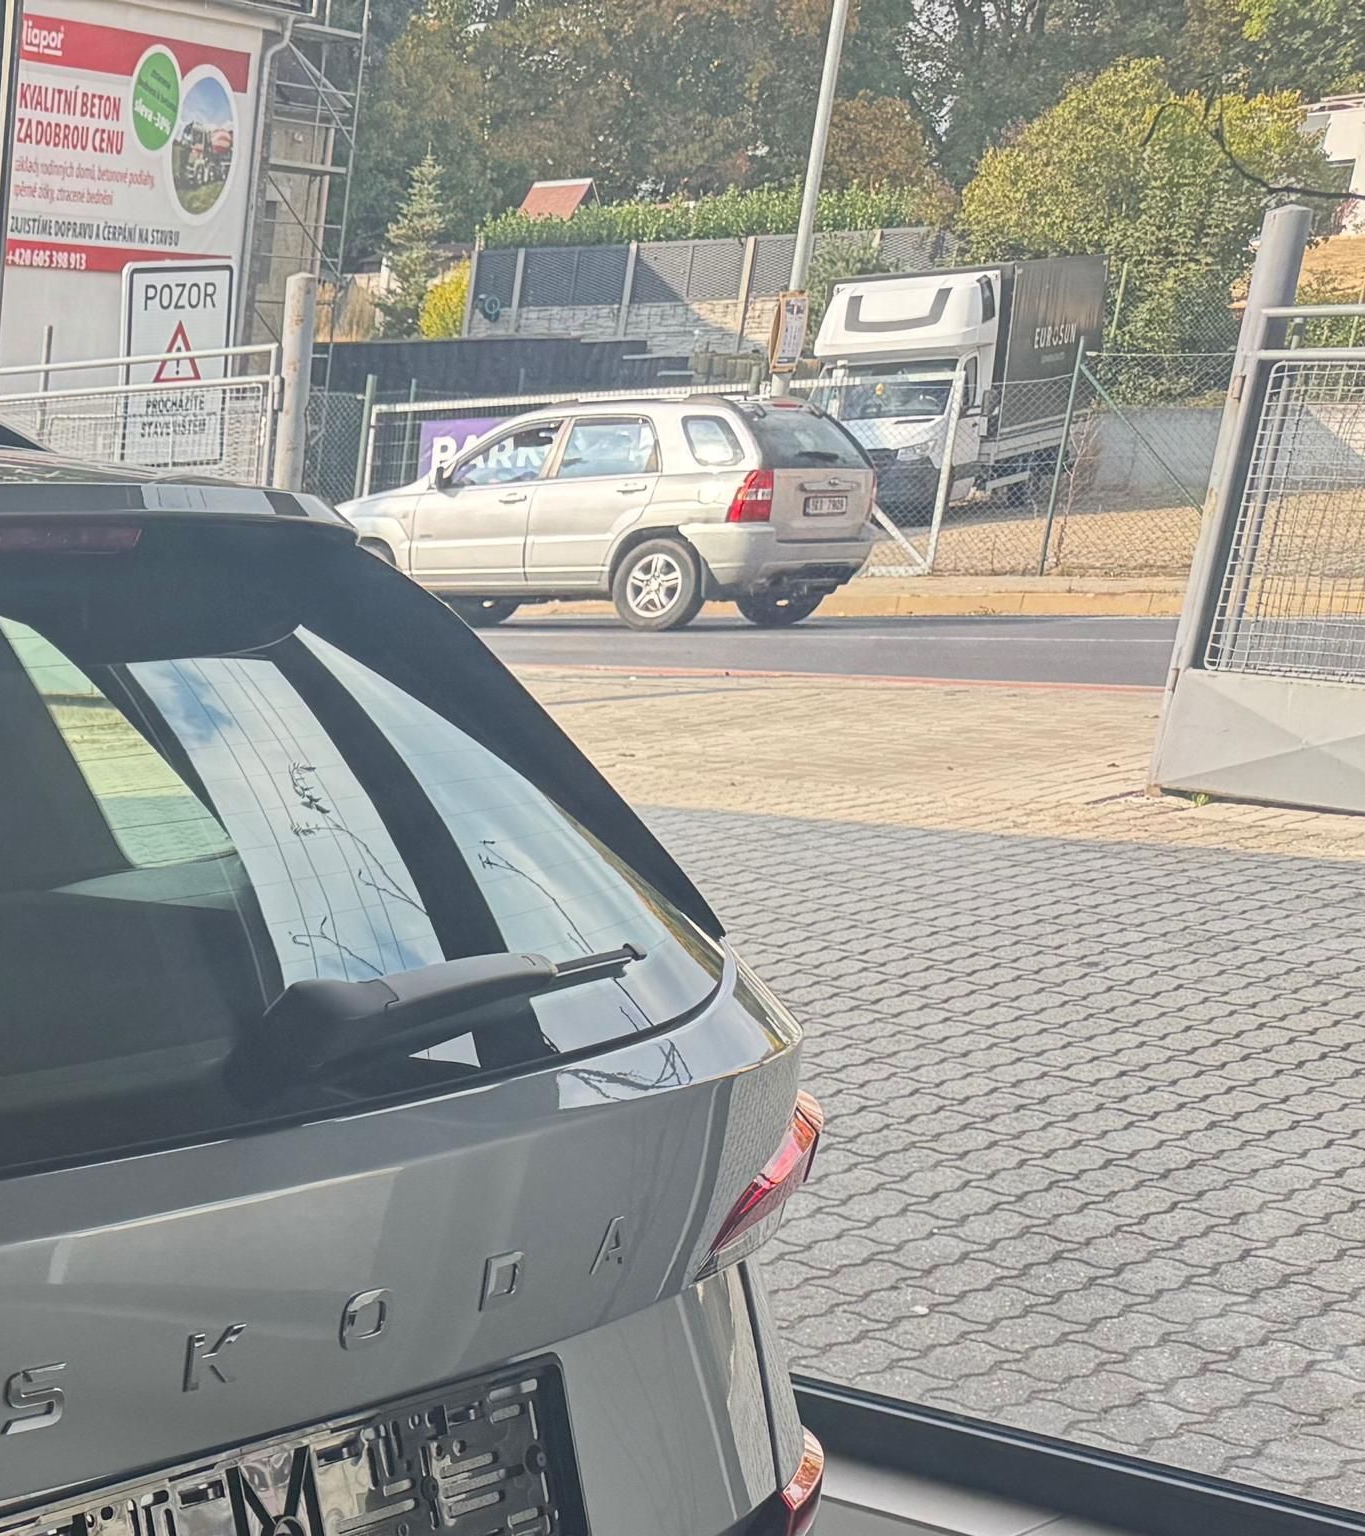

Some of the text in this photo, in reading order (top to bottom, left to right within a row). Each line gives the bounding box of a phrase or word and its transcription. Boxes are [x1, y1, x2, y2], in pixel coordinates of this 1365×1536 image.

[19, 83, 80, 116] KVALITNÍ
[80, 92, 121, 121] BETON
[16, 118, 124, 155] ZA DOBROU CENU
[10, 215, 180, 247] ZAJISTÍME DOPRAVU A ČERPÁNÍ NA STAVBU
[6, 247, 32, 265] +420
[32, 250, 50, 267] 605
[69, 252, 87, 270] 913
[144, 282, 217, 311] POZOR
[1034, 323, 1077, 349] EUROSUN
